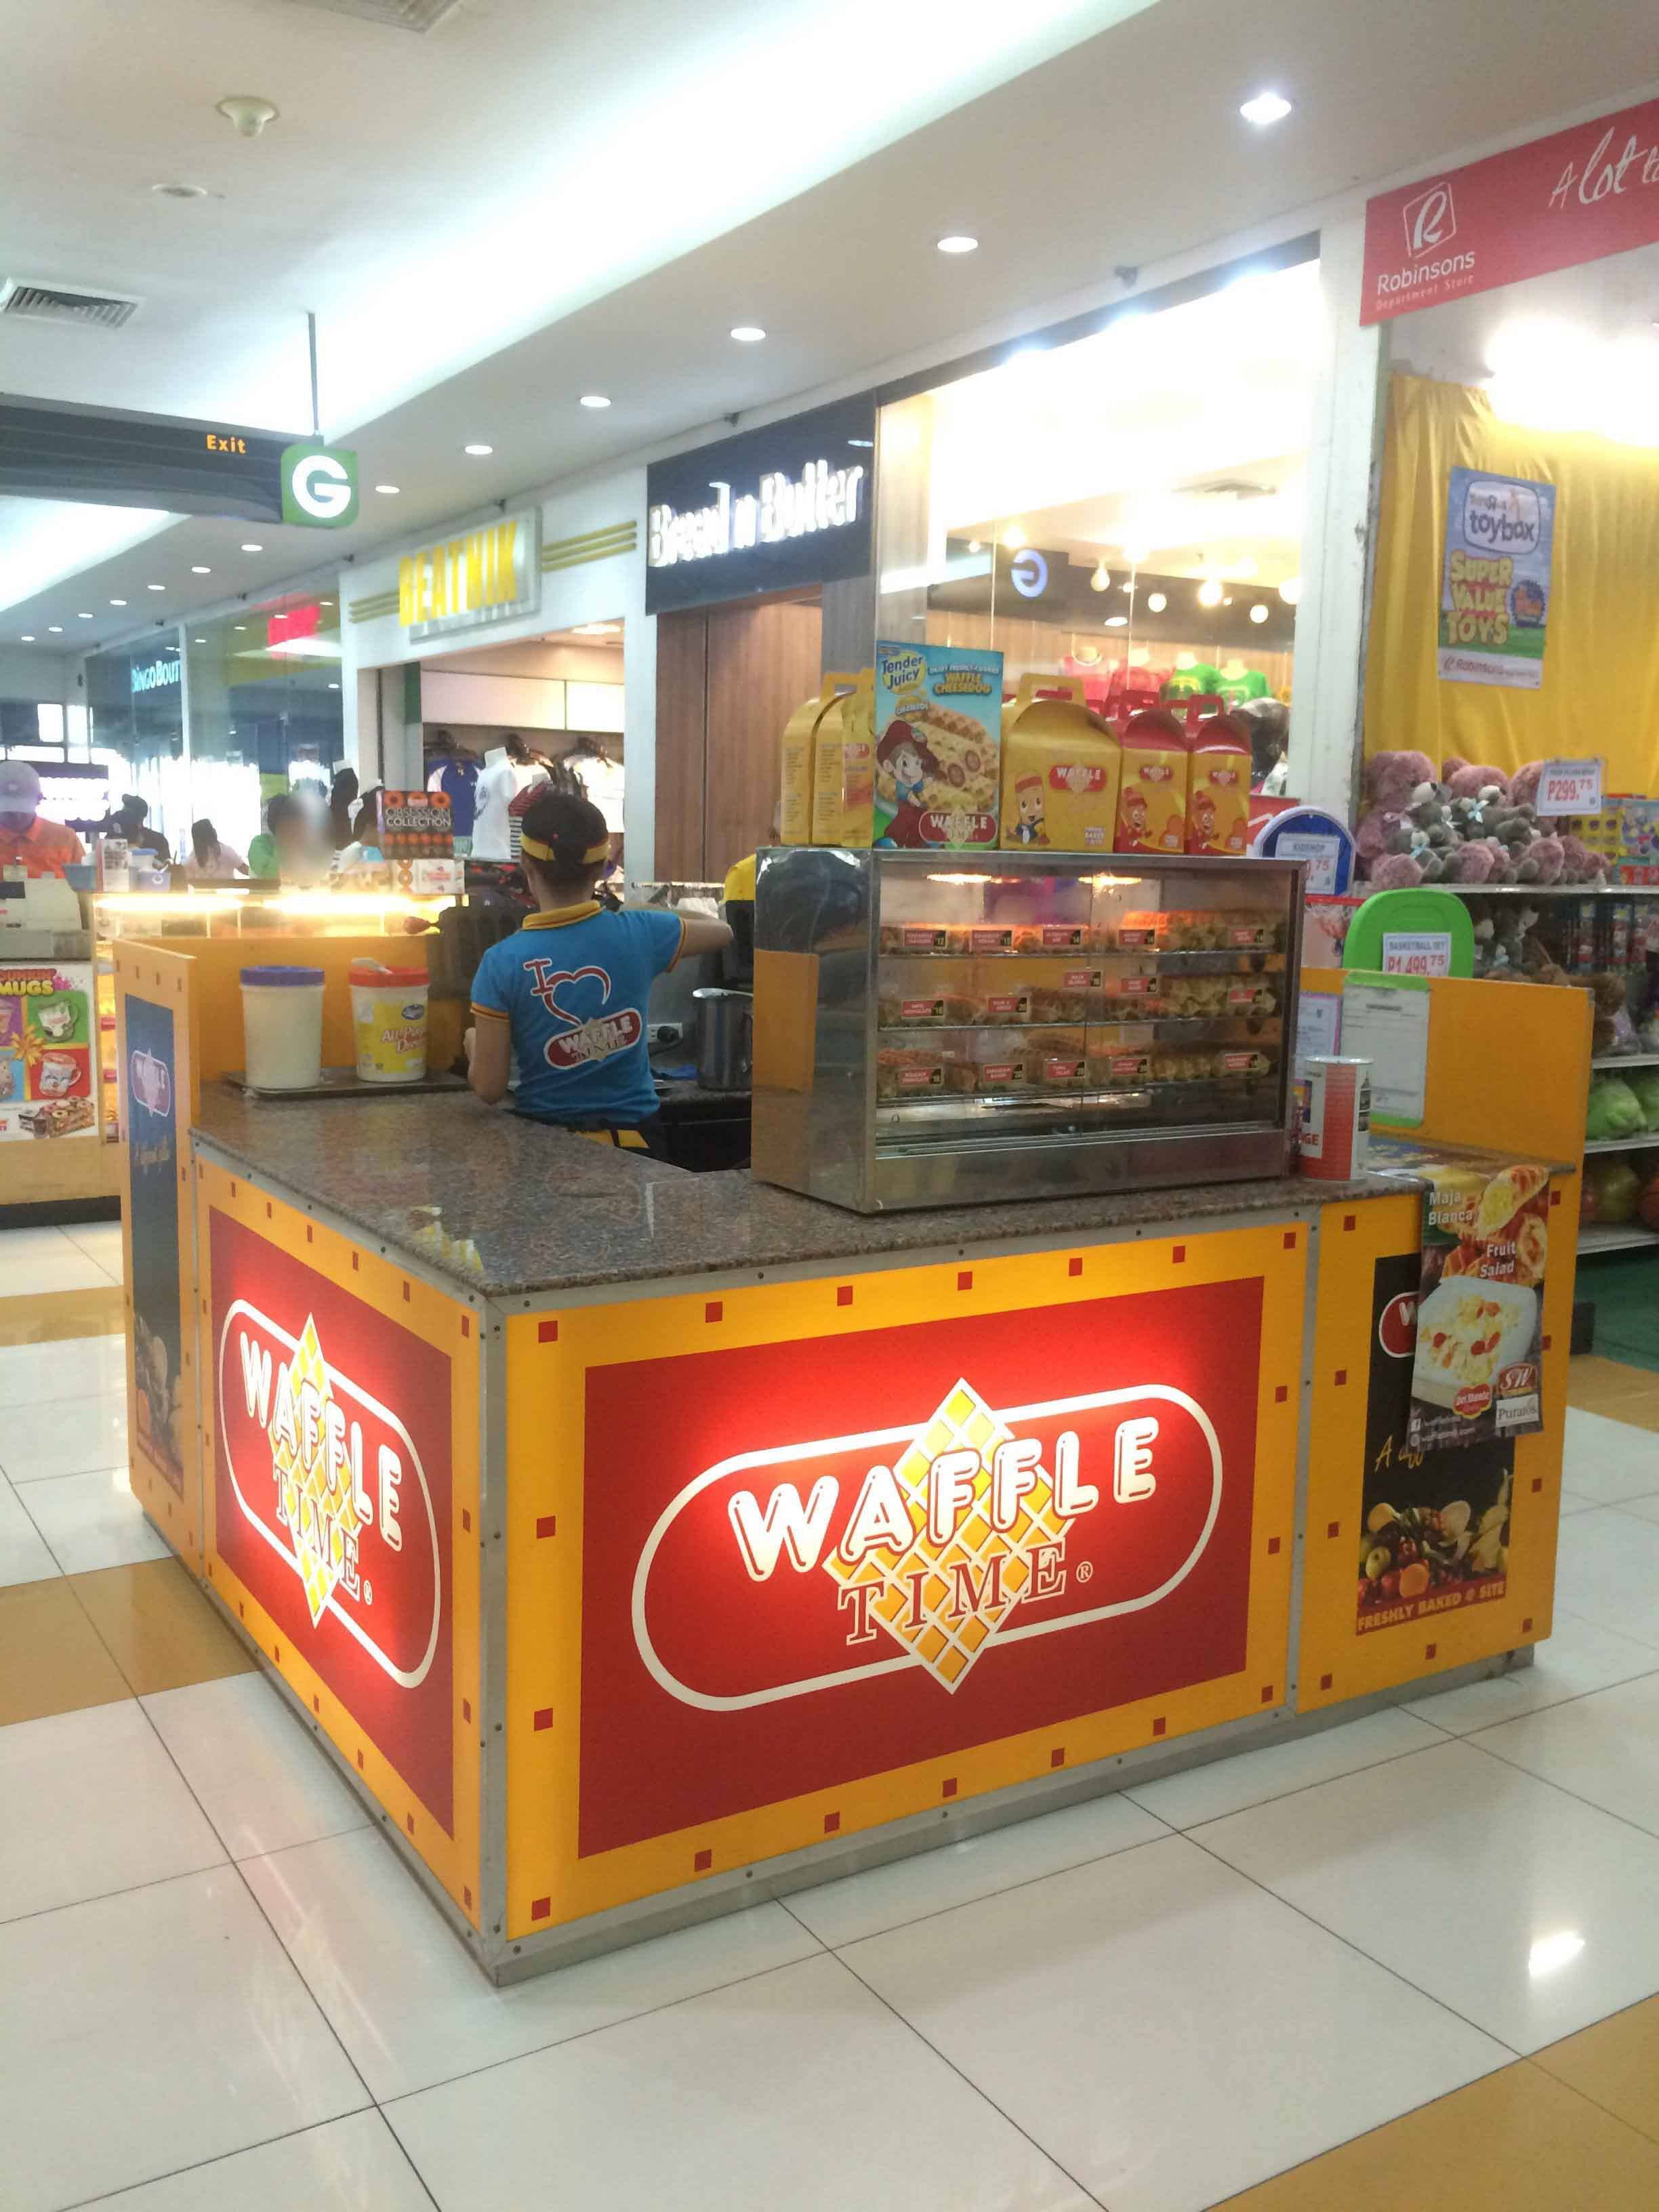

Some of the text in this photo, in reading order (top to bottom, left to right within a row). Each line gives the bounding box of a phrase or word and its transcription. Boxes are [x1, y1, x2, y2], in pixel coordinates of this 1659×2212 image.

[1549, 161, 1578, 208] A
[1578, 126, 1648, 204] lot
[1377, 251, 1475, 295] Robinsons
[1376, 274, 1475, 311] Department Store
[207, 434, 246, 454] Exit
[291, 454, 351, 518] G
[759, 459, 864, 543] Butter
[1469, 509, 1535, 544] toybox
[1450, 550, 1513, 587] SUPER
[1451, 582, 1508, 615] VALUE
[1446, 611, 1510, 645] TOYS
[882, 655, 923, 673] Tender
[886, 668, 920, 690] Juicy
[386, 806, 451, 817] OBSESSION
[386, 817, 451, 827] COLLECTION
[930, 815, 987, 830] WAFFLE
[0, 980, 54, 996] MUGS
[1429, 1190, 1461, 1206] Maja
[1428, 1210, 1474, 1226] Blanca
[1486, 1241, 1516, 1258] Fruit
[1480, 1261, 1515, 1278] Salad
[239, 1330, 403, 1552] WAFFLE
[727, 1416, 1160, 1582] WAFFLE
[272, 1467, 361, 1601] TIME
[838, 1536, 1067, 1645] TIME
[1357, 1604, 1415, 1631] FRESHLY
[1418, 1591, 1462, 1615] BAKED
[1479, 1581, 1505, 1599] SITE
